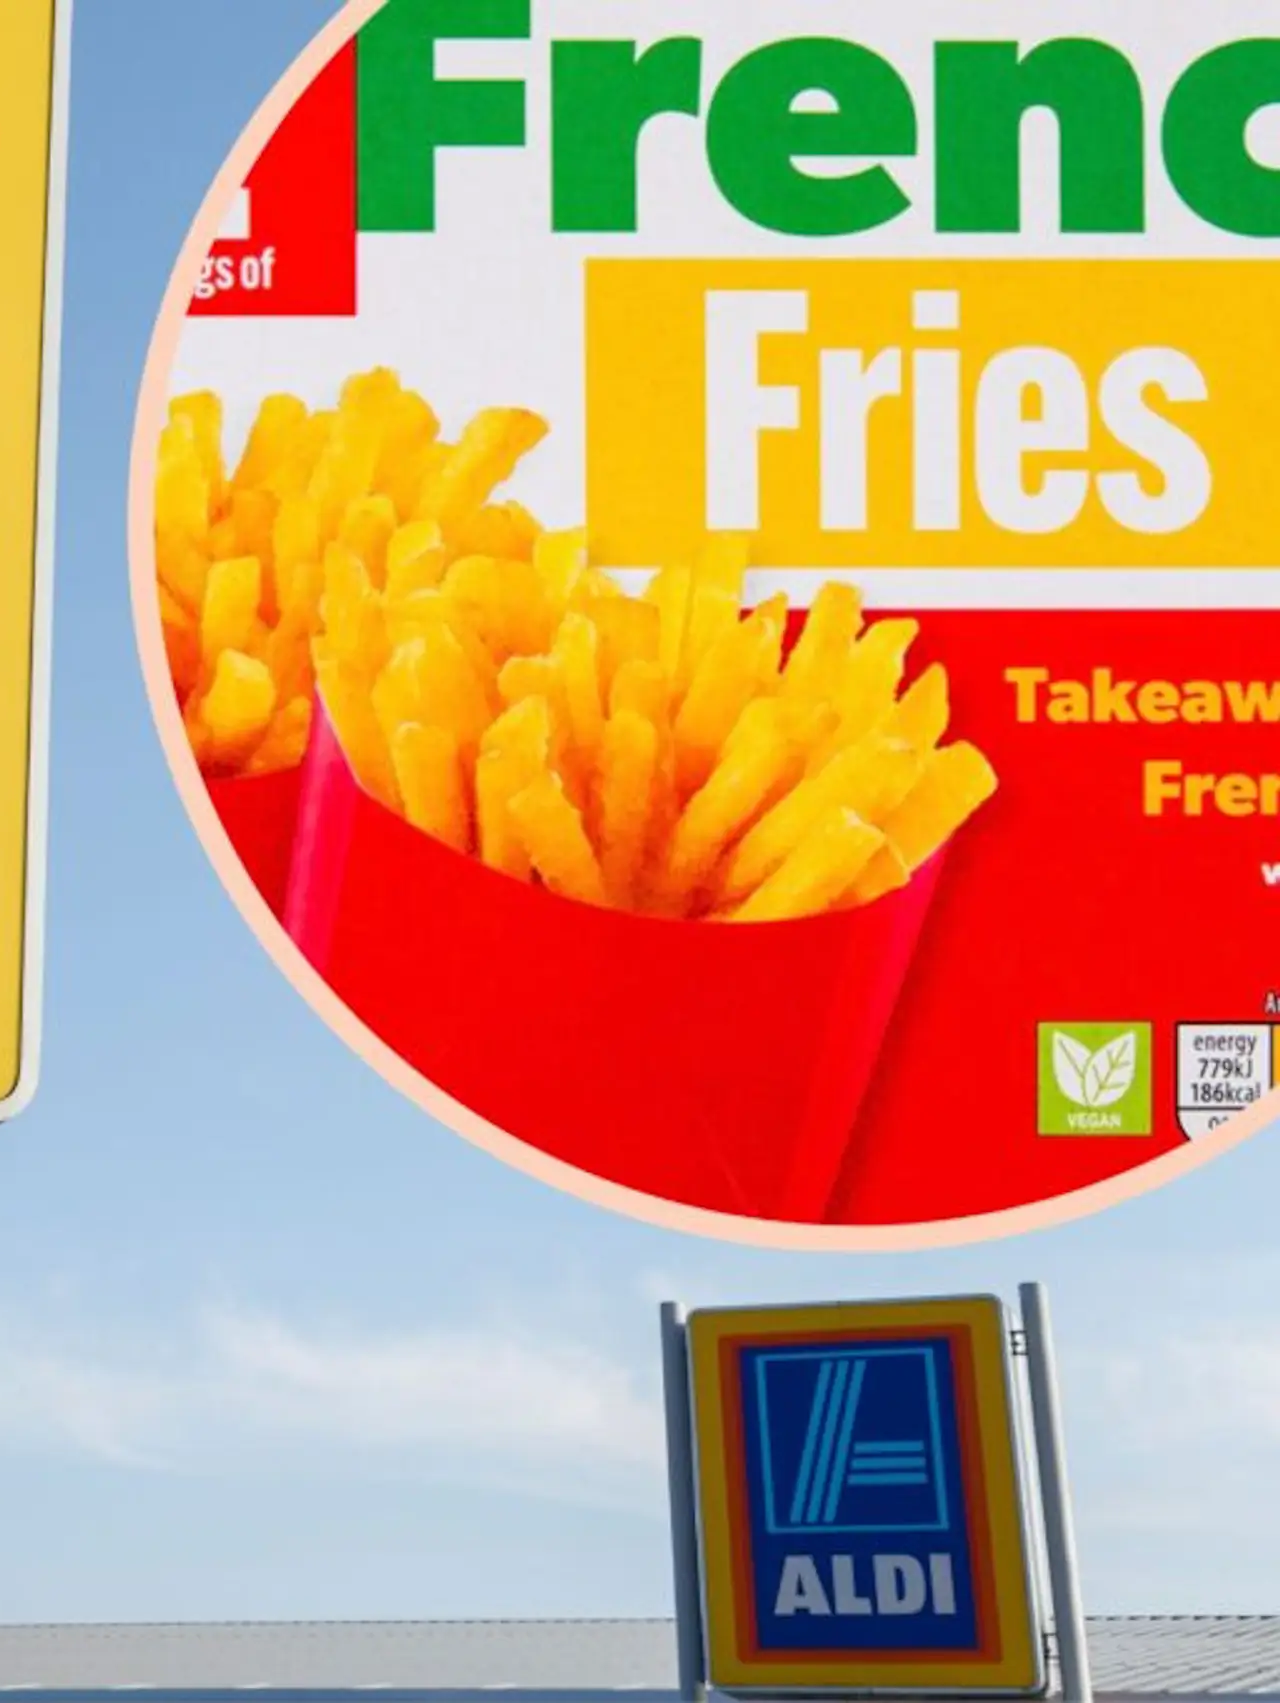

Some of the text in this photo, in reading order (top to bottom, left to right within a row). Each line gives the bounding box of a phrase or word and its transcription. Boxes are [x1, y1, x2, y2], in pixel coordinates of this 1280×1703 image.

[240, 246, 276, 290] of
[704, 290, 1213, 534] Fries
[1004, 667, 1280, 724] Takeaw
[1193, 1034, 1258, 1056] energy
[1197, 1057, 1254, 1079] 779kJ
[1191, 1082, 1262, 1103] 186kcal
[1067, 1111, 1122, 1129] VEGAN
[774, 1553, 956, 1616] ALDI
